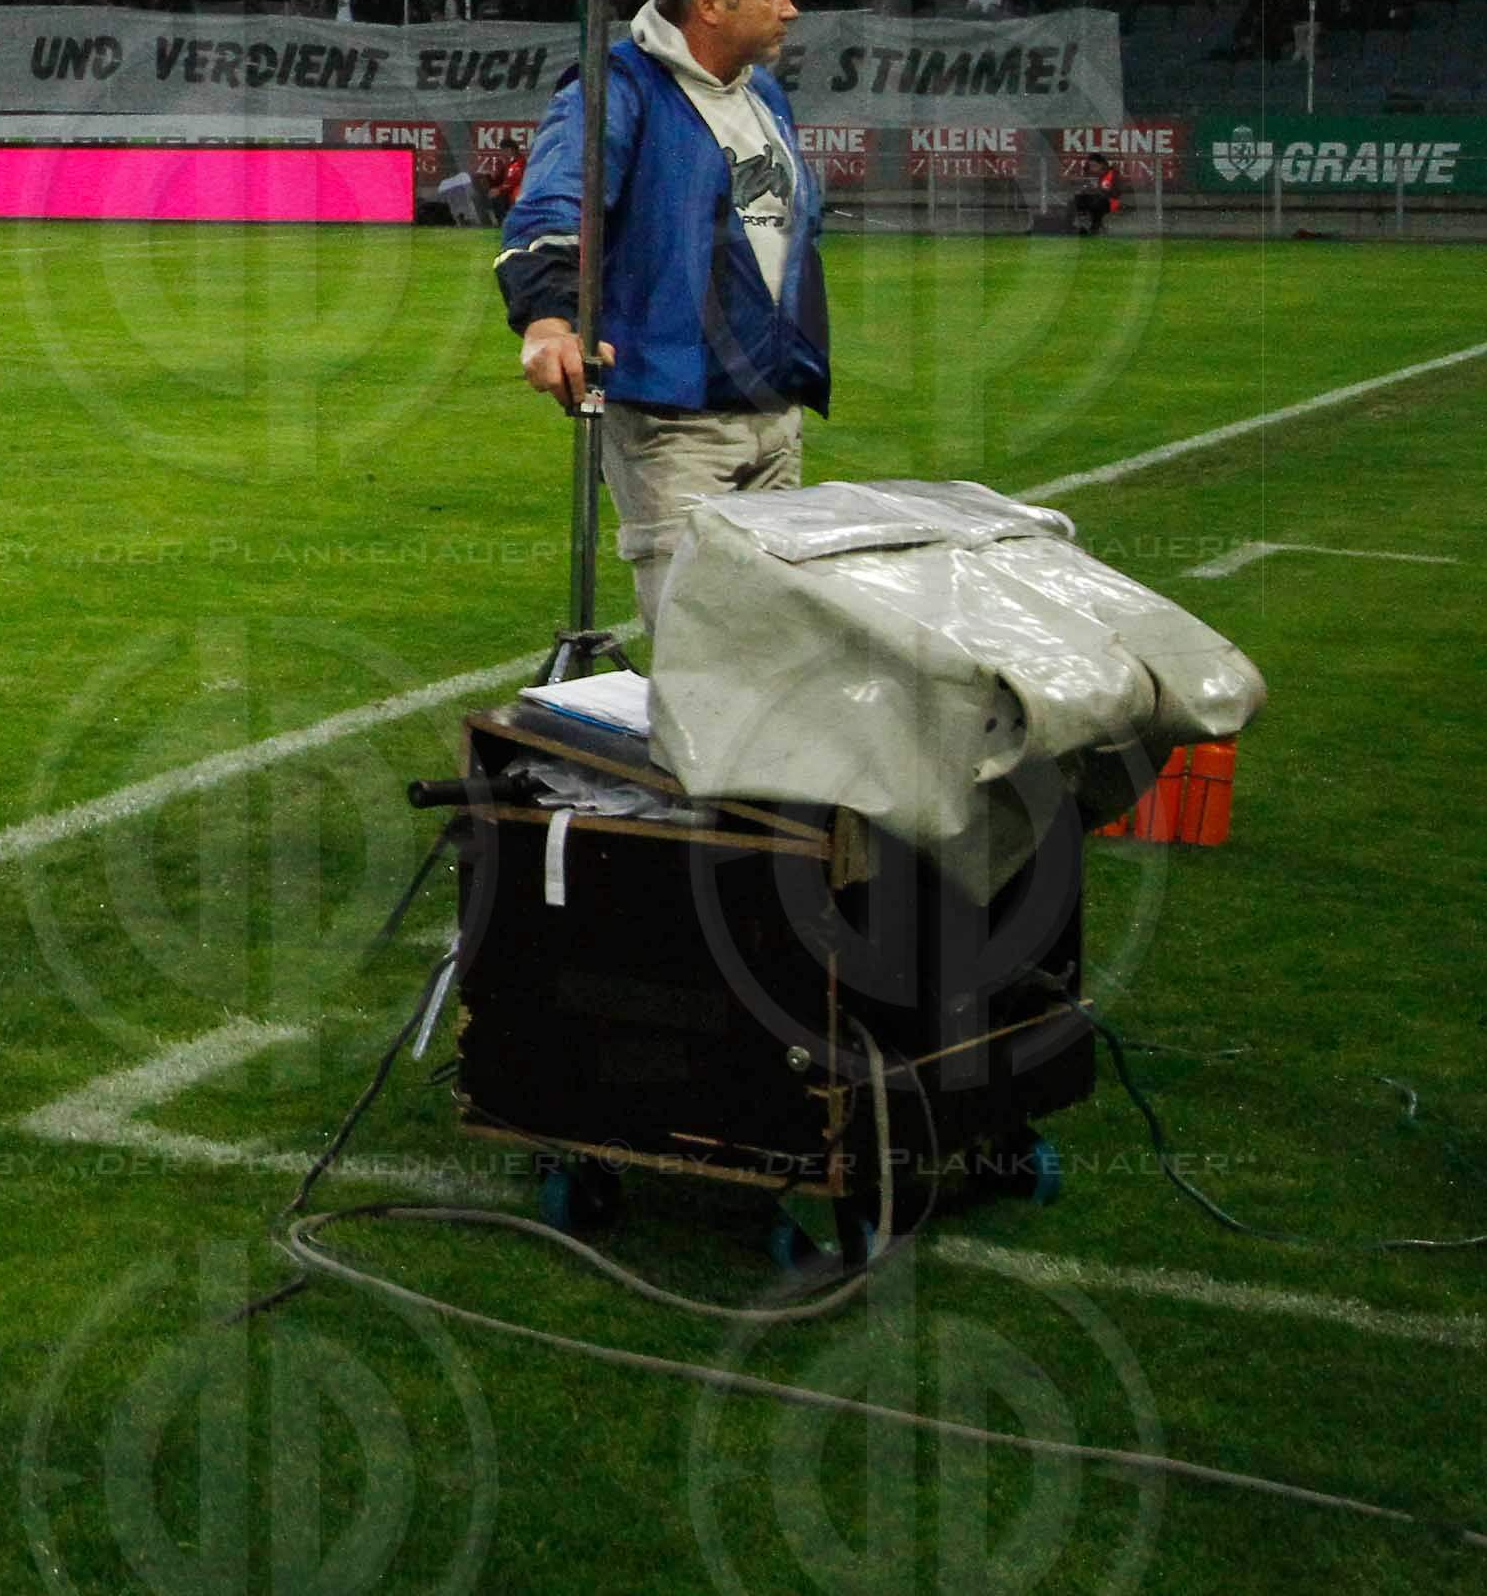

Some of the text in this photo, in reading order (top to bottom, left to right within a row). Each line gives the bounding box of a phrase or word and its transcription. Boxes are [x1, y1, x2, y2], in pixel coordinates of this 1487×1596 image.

[31, 36, 122, 80] UND
[154, 36, 390, 91] VERDIENT
[415, 46, 548, 92] EUCH
[830, 42, 1081, 97] STIMME!
[797, 128, 866, 153] EINE
[911, 128, 1017, 153] KLEINE
[1062, 129, 1173, 154] KLEINE
[1280, 141, 1462, 185] GRAWE
